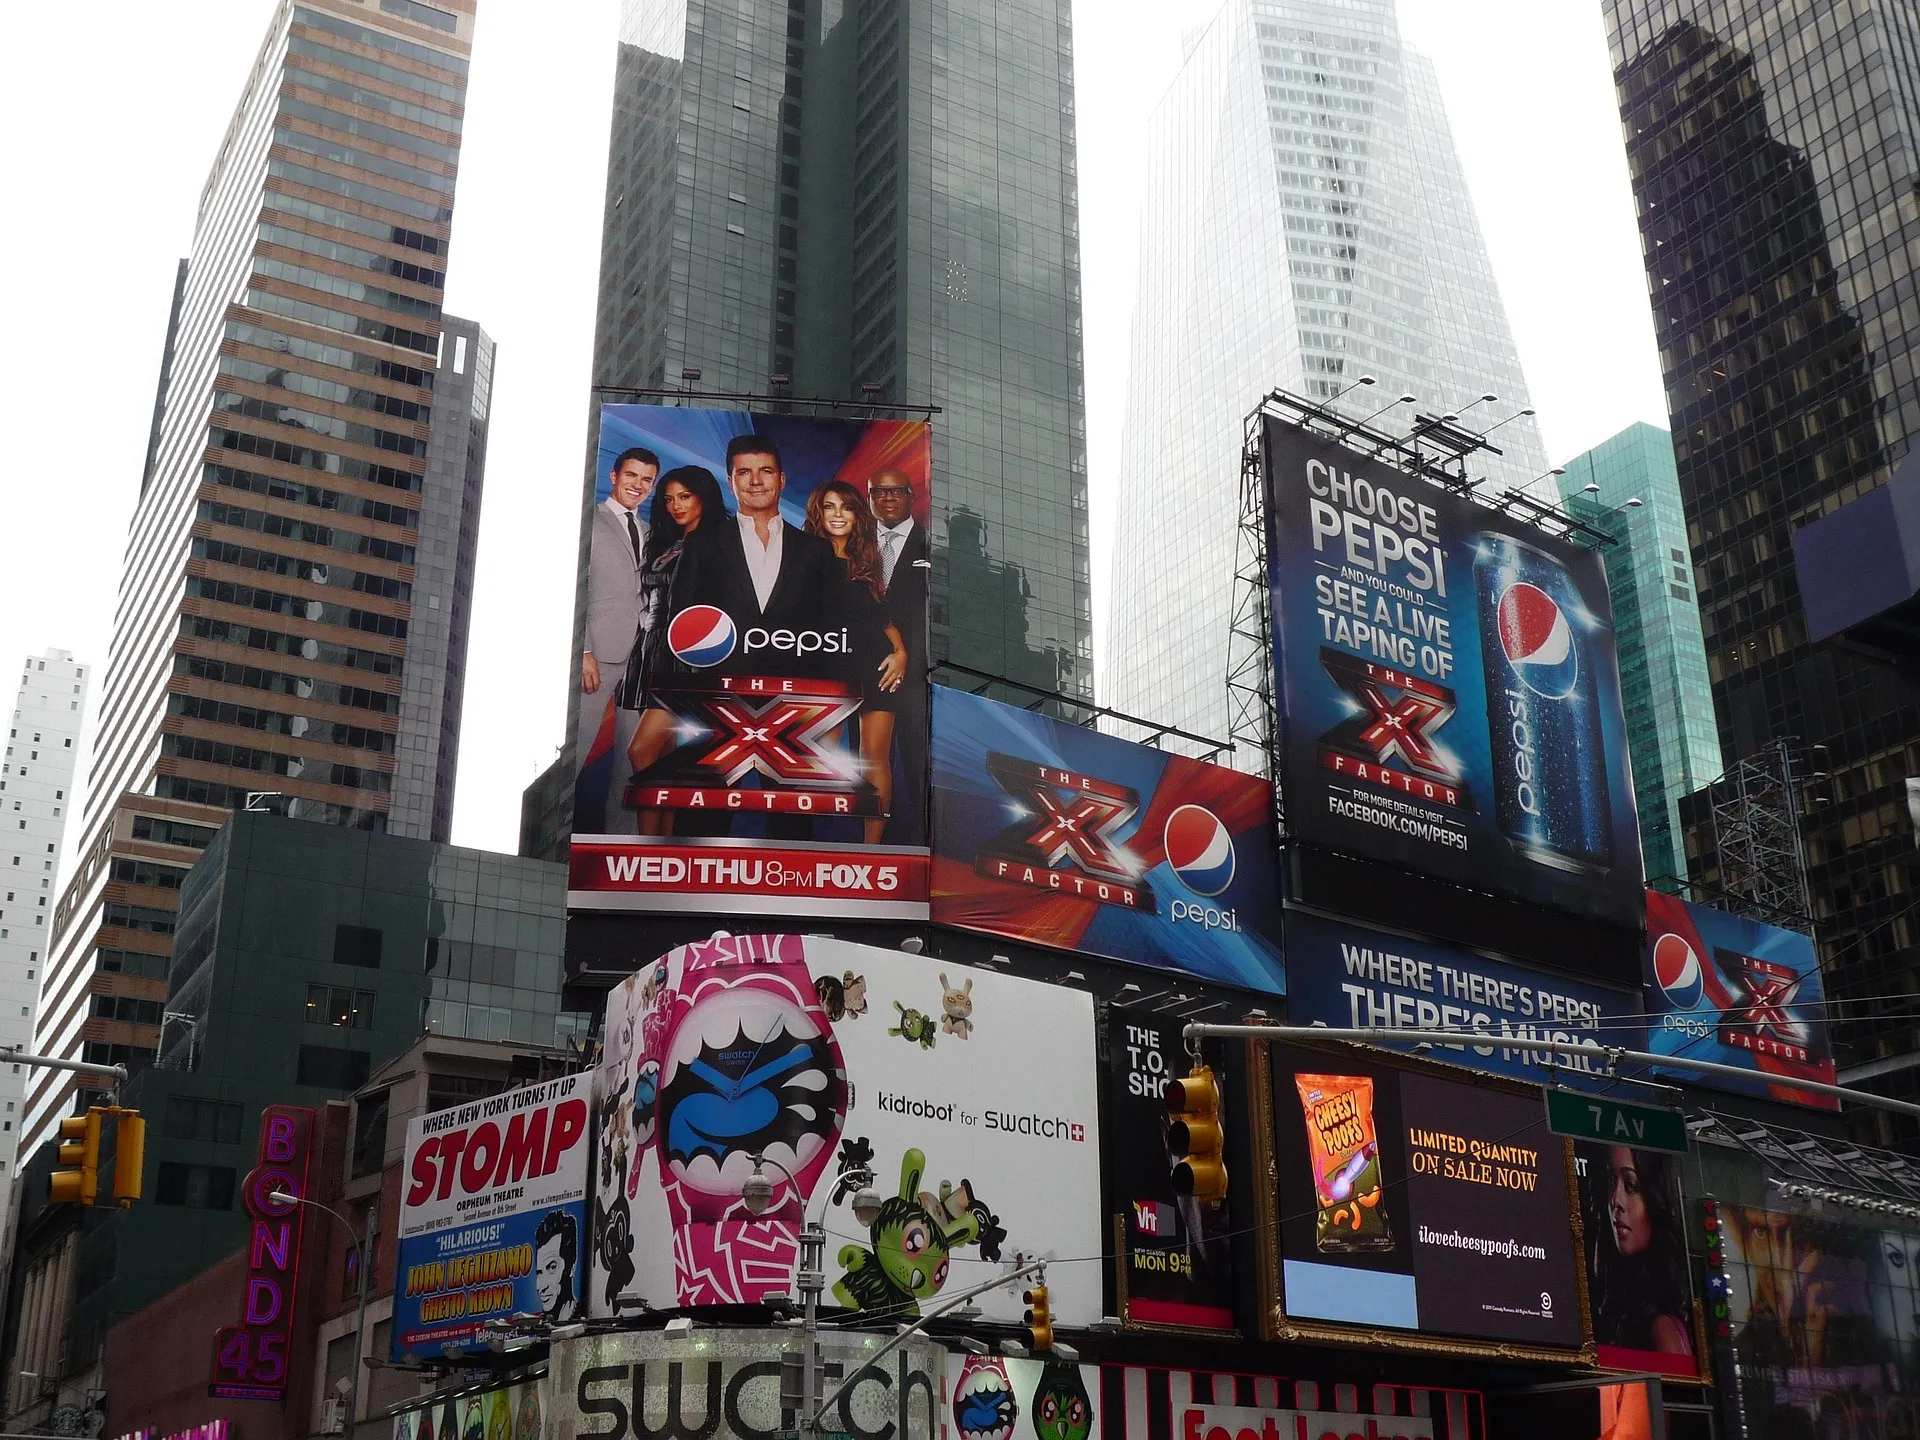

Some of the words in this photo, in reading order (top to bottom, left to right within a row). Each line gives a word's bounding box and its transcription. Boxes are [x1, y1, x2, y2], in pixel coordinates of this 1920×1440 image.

[1306, 459, 1440, 543] CHOOSE
[1309, 497, 1447, 598] PEPSI
[1340, 566, 1364, 583] AND
[1365, 574, 1387, 593] YOU
[1388, 584, 1424, 607] COULD
[1315, 575, 1368, 615] SEE
[1374, 597, 1393, 628] A
[1397, 603, 1452, 650] LIVE
[744, 627, 849, 657] pepsi
[1317, 608, 1417, 668] TAPING
[1422, 646, 1454, 680] OF
[721, 677, 794, 692] THE
[1366, 663, 1413, 687] THE
[1505, 688, 1541, 816] pepsi
[1039, 766, 1091, 790] THE
[1335, 757, 1456, 805] FACTOR
[656, 790, 850, 813] FACTOR
[1353, 789, 1369, 802] FOR
[1370, 793, 1393, 810] MORE
[1393, 799, 1425, 817] DETAILS
[1425, 807, 1444, 824] VISIT
[1328, 796, 1468, 851] FACEBOOK.COM/PEPSI
[765, 861, 813, 888] 8PM
[816, 863, 873, 890] FOX
[877, 866, 898, 890] 5
[998, 863, 1134, 905] FACTOR
[1171, 900, 1237, 931] pepsi
[1742, 957, 1773, 973] THE
[1341, 943, 1434, 993] WHERE
[1436, 965, 1534, 1016] THERE'S
[1538, 990, 1601, 1032] PEPSI
[1126, 1025, 1160, 1049] THE
[1342, 983, 1495, 1056] THERE'S
[1663, 1014, 1709, 1038] pepsi
[1729, 1033, 1808, 1061] FACTOR
[422, 1116, 456, 1135] WHERE
[458, 1110, 483, 1126] NEW
[483, 1100, 509, 1119] YORK
[512, 1086, 546, 1109] TURNS
[547, 1083, 560, 1100] IT
[561, 1078, 577, 1096] UP
[878, 1091, 953, 1121] kidrobot
[960, 1111, 978, 1126] for
[985, 1110, 1069, 1140] swatch
[1314, 1090, 1357, 1131] CHEESY
[1588, 1106, 1602, 1131] 7
[406, 1098, 587, 1207] STOMP
[1322, 1116, 1364, 1156] POOFS
[1410, 1128, 1467, 1153] LIMITED
[1470, 1140, 1538, 1168] QUANTITY
[1412, 1151, 1439, 1175] ON
[1443, 1157, 1493, 1185] SALE
[1496, 1167, 1538, 1192] NOW
[456, 1194, 491, 1212] ORPHEUM
[493, 1187, 524, 1204] THEATRE
[505, 1202, 517, 1213] Street
[247, 1116, 299, 1326] BOND
[1135, 1253, 1166, 1271] MON
[1418, 1225, 1546, 1260] ilovecheesypoofs.com
[405, 1261, 446, 1298] JOHN
[448, 1243, 533, 1290] LEGUIZAMO
[420, 1293, 466, 1324] GHETTO
[468, 1282, 514, 1315] KLOWN
[219, 1331, 285, 1382] 45
